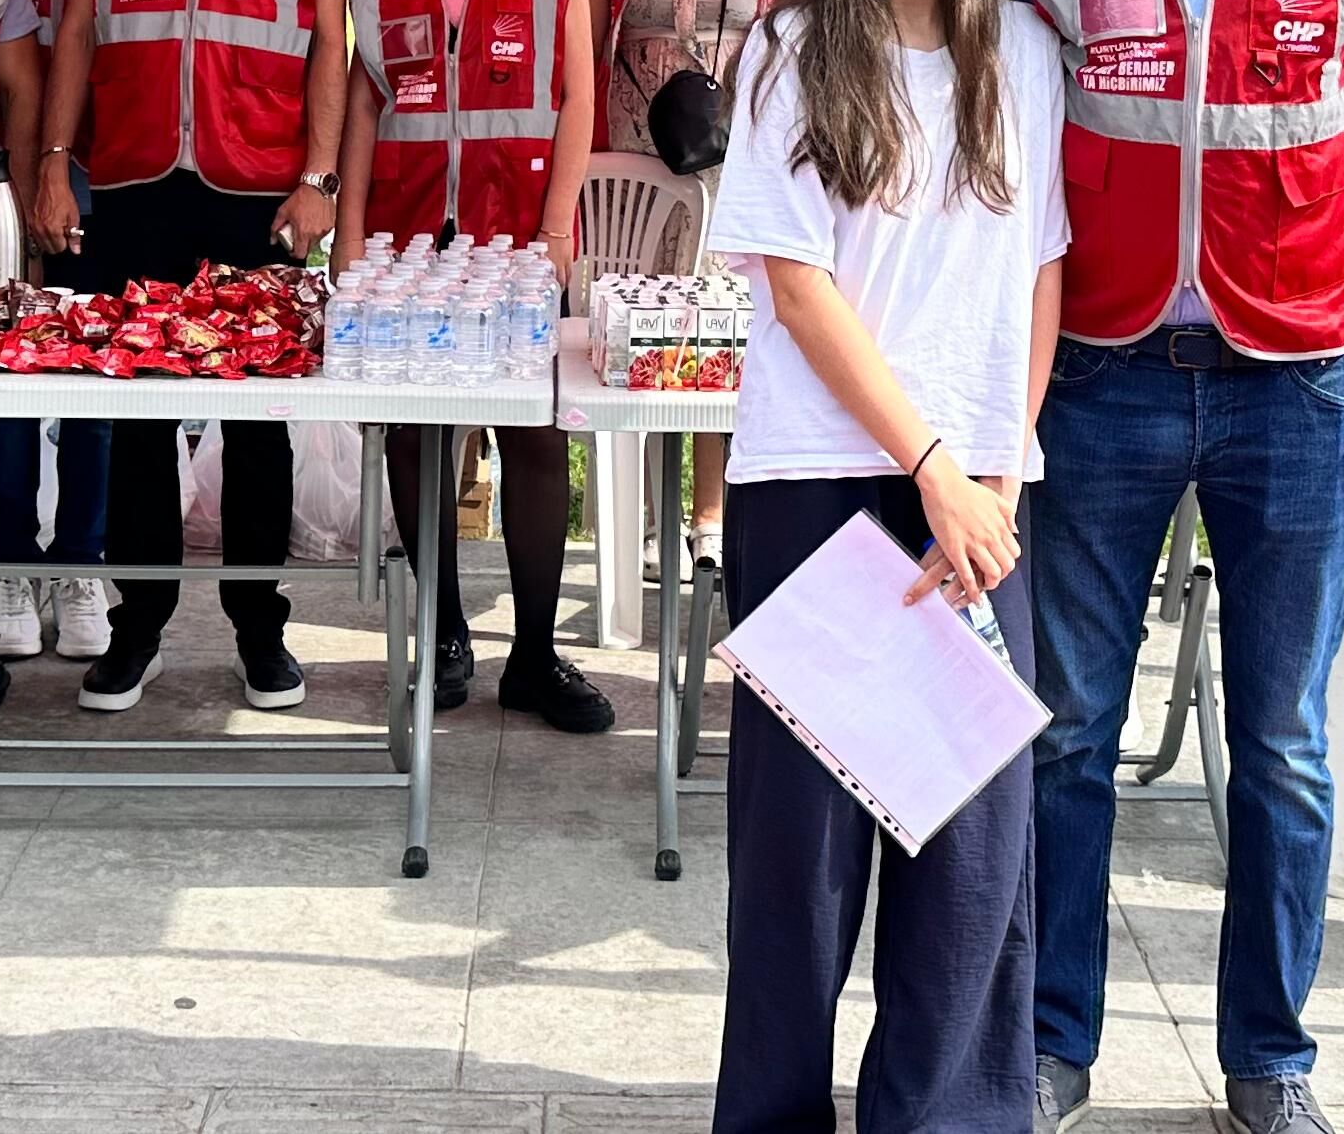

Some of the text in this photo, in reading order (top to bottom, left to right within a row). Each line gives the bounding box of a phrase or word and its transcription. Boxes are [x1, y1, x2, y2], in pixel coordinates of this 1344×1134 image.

[1273, 20, 1325, 42] CHP
[491, 40, 524, 55] CHP
[1097, 55, 1116, 63] TEK
[1118, 61, 1175, 76] BERABER
[1083, 74, 1096, 89] YA
